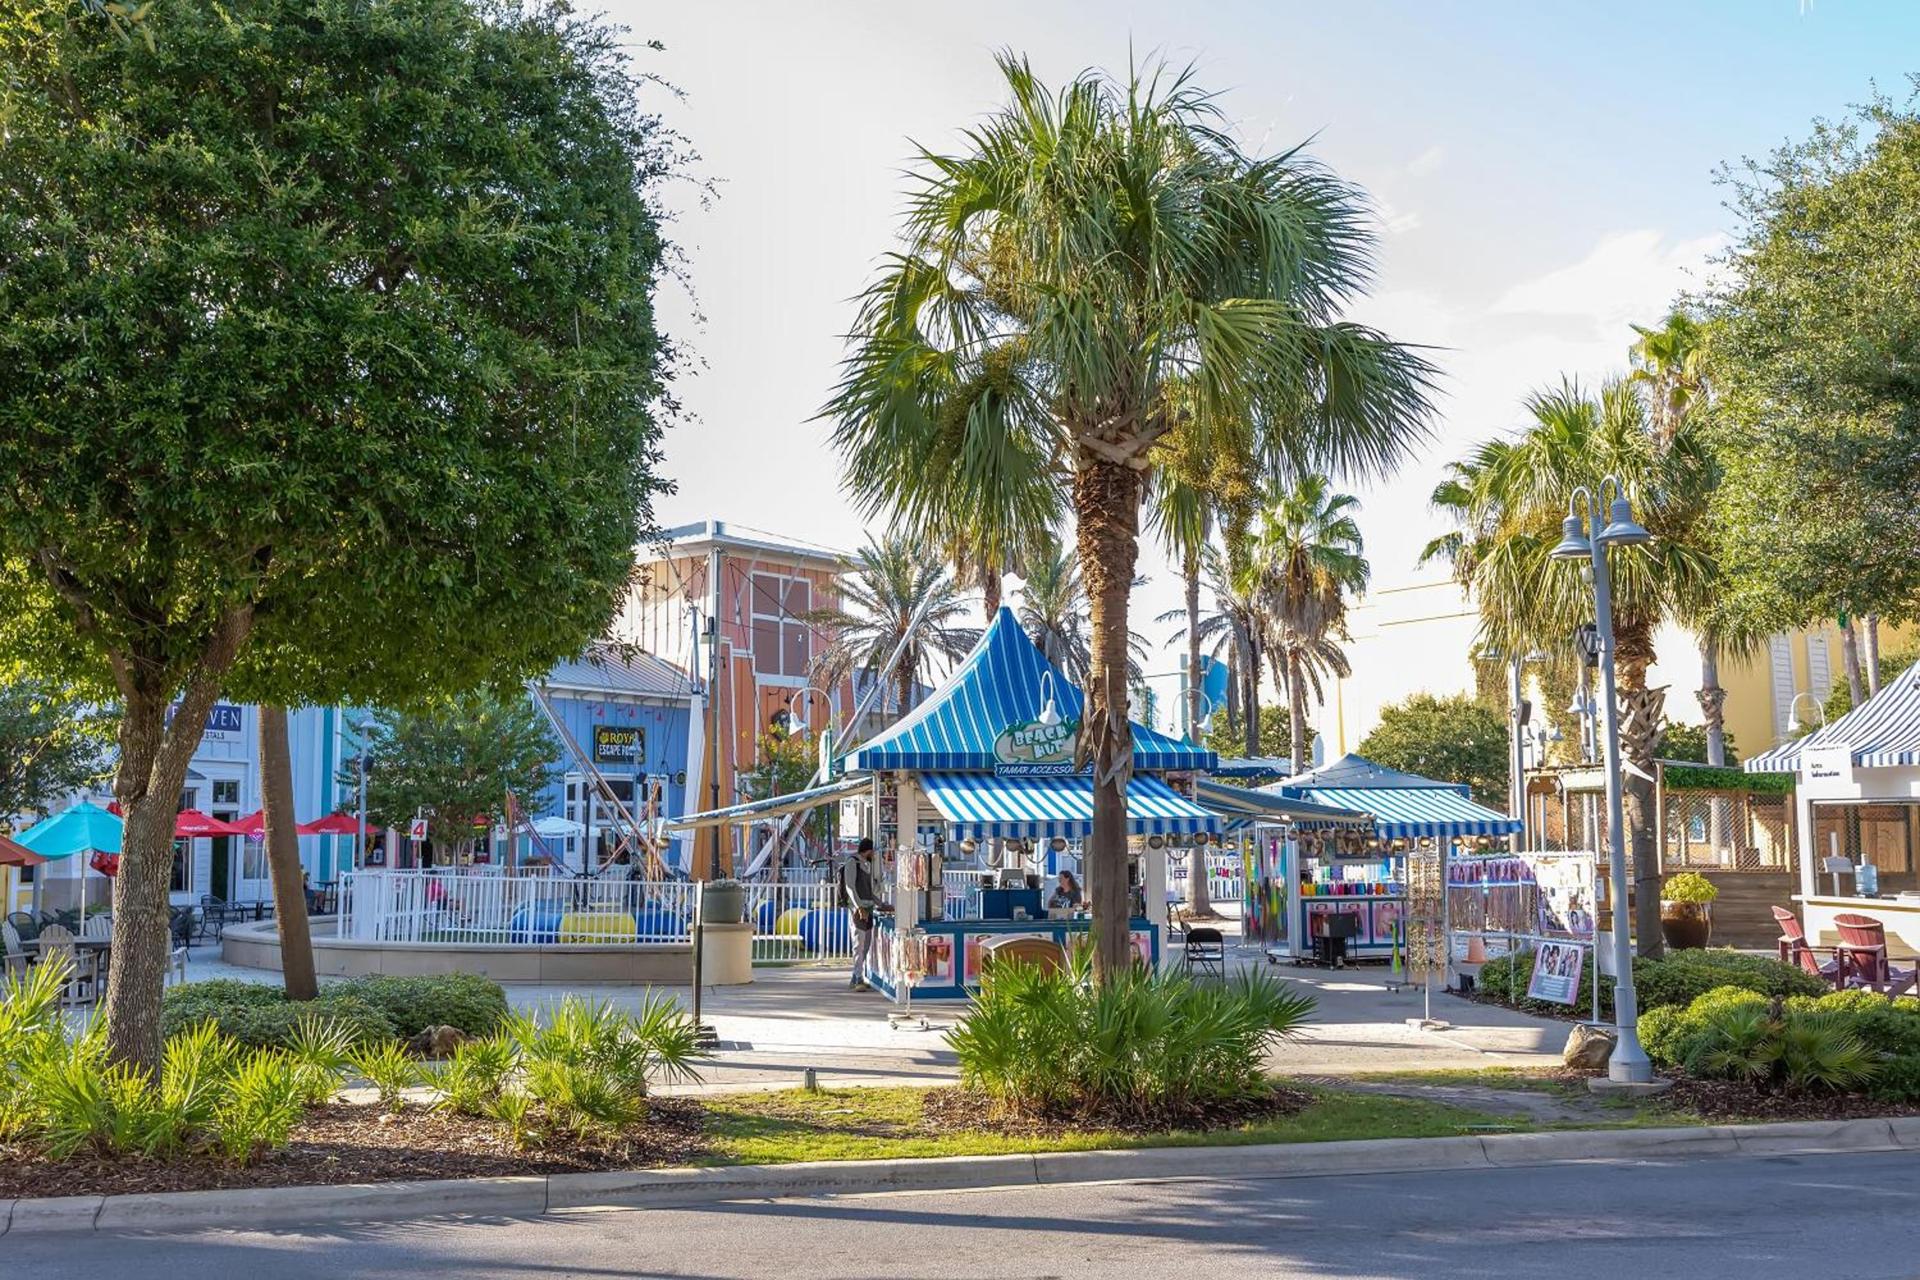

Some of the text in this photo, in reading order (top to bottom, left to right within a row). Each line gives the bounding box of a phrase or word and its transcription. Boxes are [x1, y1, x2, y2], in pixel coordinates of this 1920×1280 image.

[1014, 725, 1067, 746] BEACH
[1034, 740, 1064, 759] HUT
[999, 764, 1093, 774] TAMAR ACCESSOS
[412, 821, 425, 839] 4
